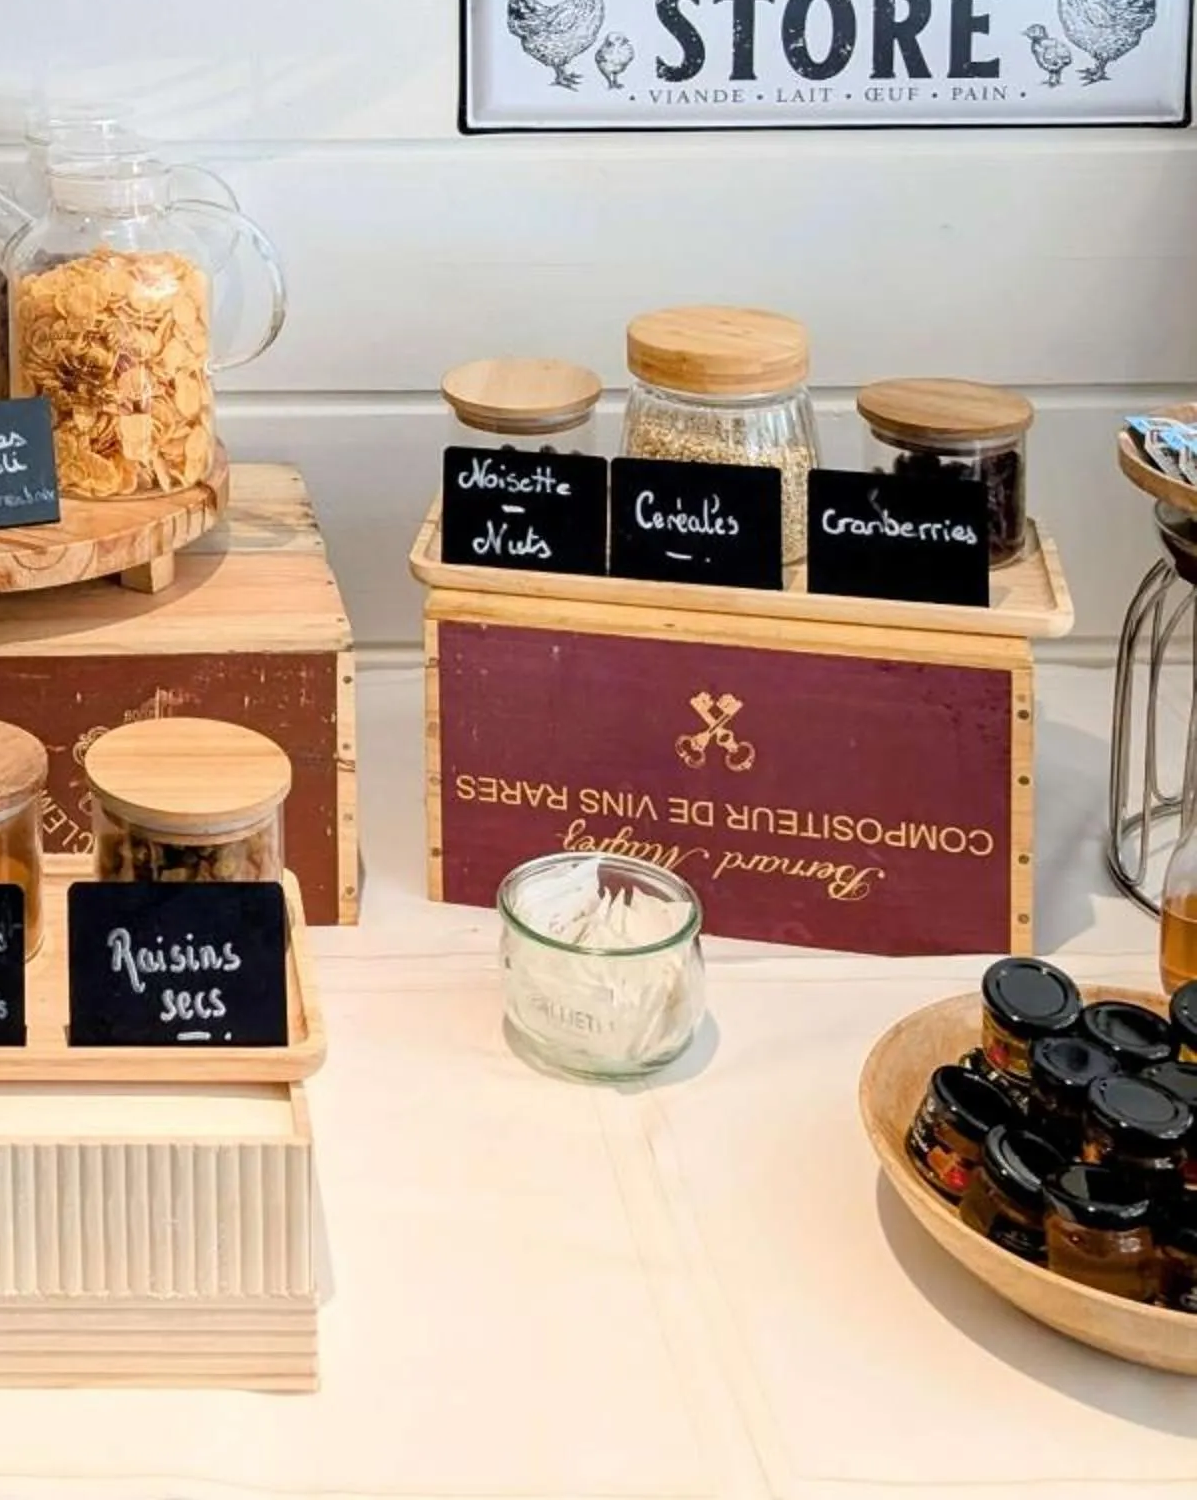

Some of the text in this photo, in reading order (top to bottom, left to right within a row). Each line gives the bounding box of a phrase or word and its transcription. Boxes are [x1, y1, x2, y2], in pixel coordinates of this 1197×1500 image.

[648, 86, 1008, 104] VIANDE LAIT ŒUF PAIN
[458, 457, 571, 495] Noisette
[471, 519, 552, 558] Nuts
[822, 508, 978, 545] Cranberries
[456, 775, 994, 856] COMPOSITEUR DE VINS RARES
[714, 851, 886, 900] Bernard
[107, 927, 242, 993] Raisins
[160, 988, 226, 1022] secs
